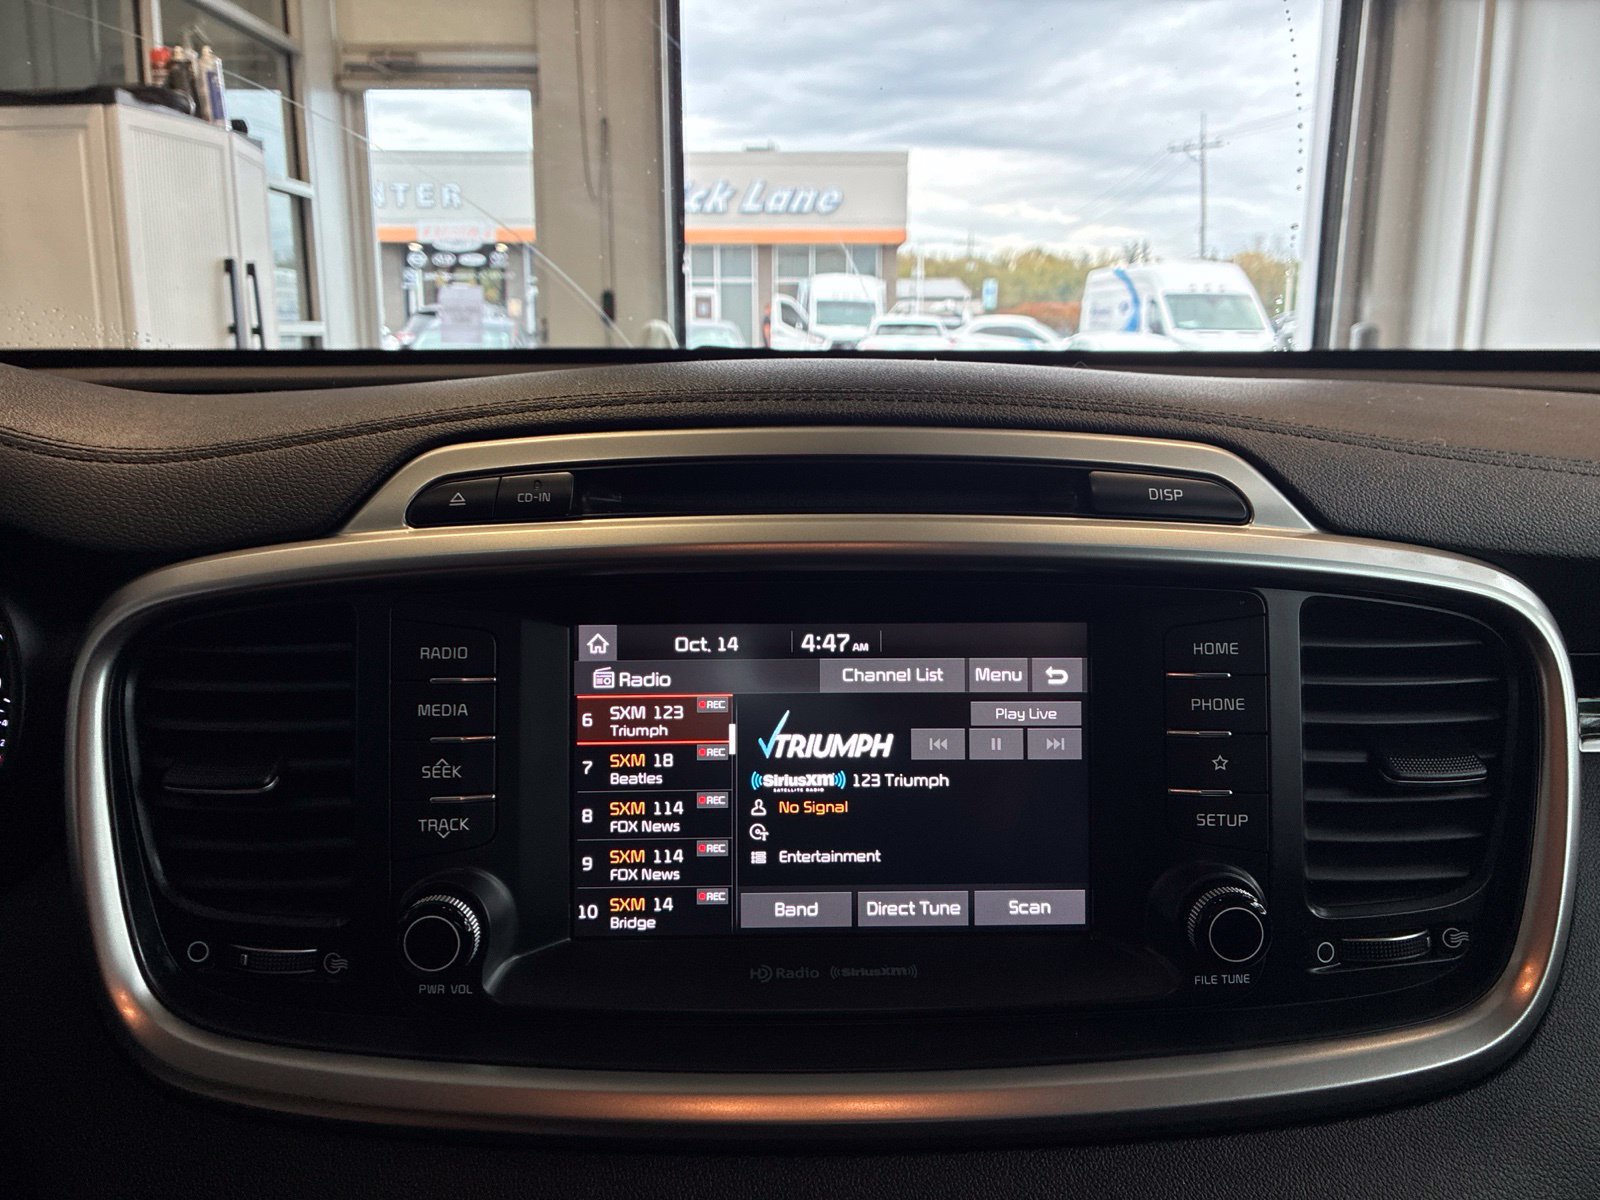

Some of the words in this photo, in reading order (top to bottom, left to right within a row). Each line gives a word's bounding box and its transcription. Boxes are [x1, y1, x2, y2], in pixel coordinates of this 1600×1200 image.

[737, 178, 844, 216] Lane
[517, 492, 551, 503] CD-IN
[1148, 487, 1183, 501] DISP
[674, 636, 712, 653] Oct.
[717, 636, 739, 652] 14
[800, 633, 851, 653] 4:47
[851, 642, 869, 652] AM
[1193, 642, 1239, 655] HOME
[420, 646, 468, 660] RADIO
[619, 671, 672, 688] Radio
[842, 667, 912, 683] Channel
[915, 667, 944, 682] List
[975, 667, 1023, 682] Menu
[417, 703, 469, 717] MEDIA
[705, 700, 726, 710] REC
[1191, 697, 1245, 711] PHONE
[581, 712, 593, 728] 6
[609, 705, 646, 721] SXM
[653, 705, 684, 720] 123
[995, 707, 1026, 722] Play
[1028, 707, 1058, 720] Live
[609, 724, 669, 739] Triumph
[705, 747, 726, 757] REC
[772, 732, 896, 760] TRIUMPH
[582, 760, 593, 775] 7
[609, 753, 646, 768] SXM
[653, 752, 674, 768] 18
[421, 765, 462, 779] SEEK
[609, 772, 663, 785] Beatles
[852, 773, 881, 788] 123
[884, 773, 950, 790] Triumph
[705, 795, 726, 805] REC
[609, 801, 646, 816] SXM
[653, 800, 684, 816] 114
[778, 800, 800, 814] No
[803, 800, 849, 816] Signal
[581, 808, 593, 824] 8
[1196, 813, 1249, 827] SETUP
[417, 817, 470, 833] TRACK
[609, 820, 639, 833] FOX
[641, 820, 681, 833] News
[705, 843, 726, 853] REC
[609, 849, 646, 864] SXM
[653, 848, 684, 864] 114
[778, 849, 882, 864] Entertainment
[581, 856, 593, 872] 9
[609, 868, 639, 881] FOX
[641, 867, 681, 881] News
[705, 891, 726, 902] REC
[578, 904, 599, 920] 10
[609, 897, 646, 912] SXM
[653, 897, 674, 912] 14
[774, 901, 819, 917] Band
[866, 900, 916, 917] Direct
[918, 900, 962, 916] Tune
[1008, 899, 1052, 915] Scan
[610, 916, 657, 931] Bridge
[776, 967, 819, 979] Radio
[1194, 974, 1218, 985] FILE
[1221, 973, 1250, 984] TUNE
[418, 983, 446, 995] PWR
[450, 984, 473, 995] VOL
